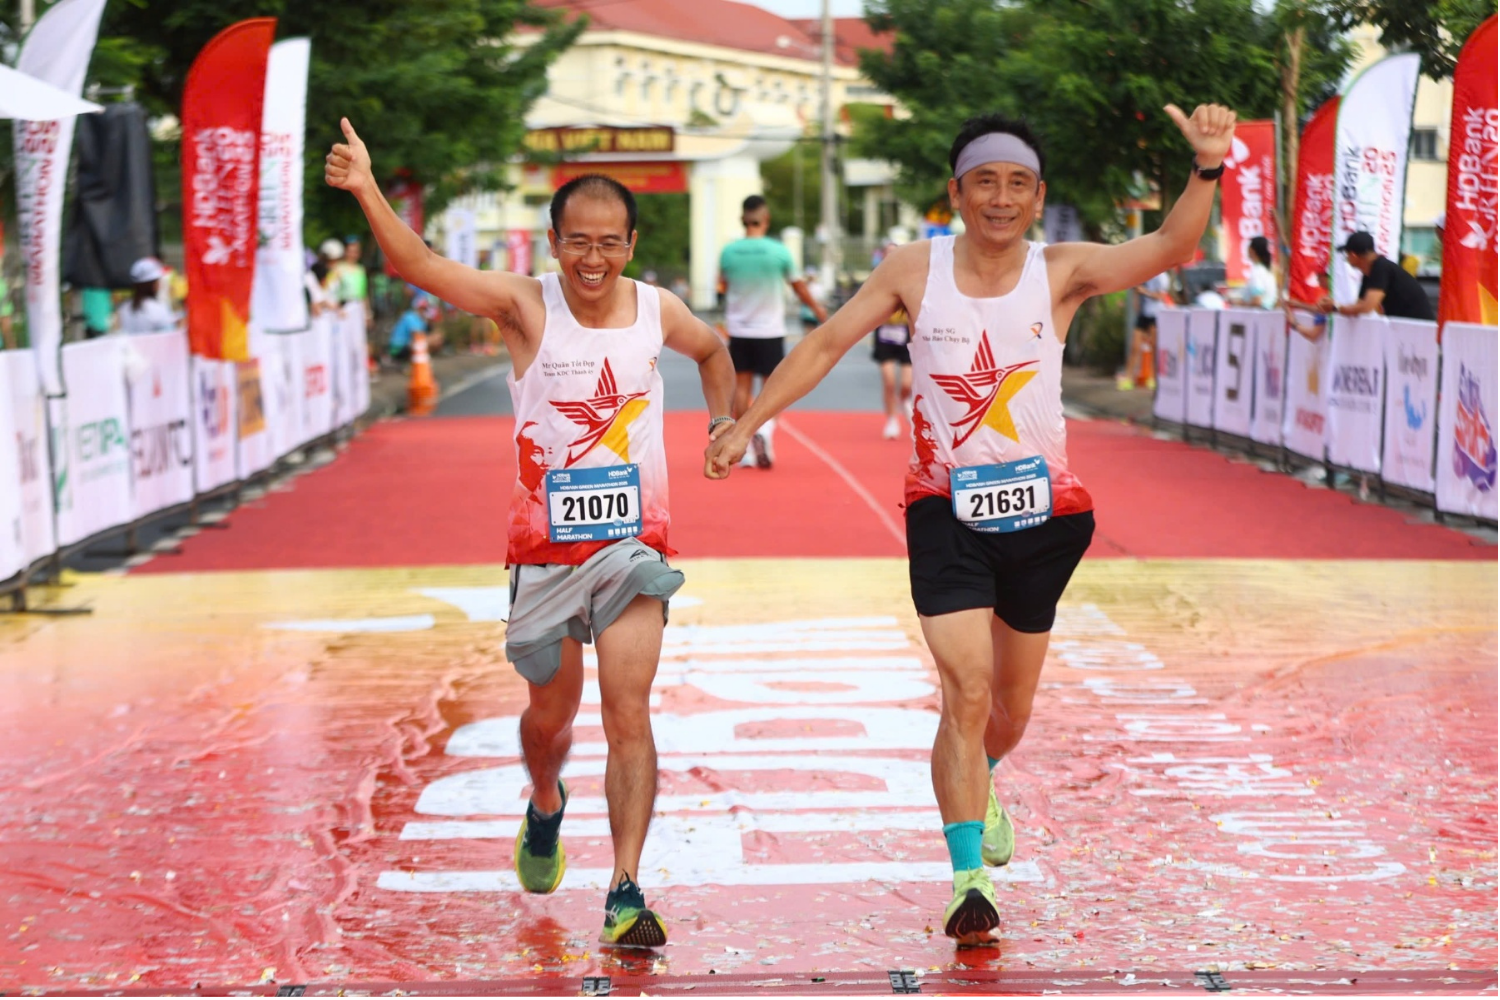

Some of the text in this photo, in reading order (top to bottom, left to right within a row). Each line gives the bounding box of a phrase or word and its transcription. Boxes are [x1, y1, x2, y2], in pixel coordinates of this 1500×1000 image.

[1456, 106, 1485, 212] HDBank
[562, 492, 629, 522] 21070
[970, 485, 1035, 518] 21631
[556, 533, 593, 541] MARATHON
